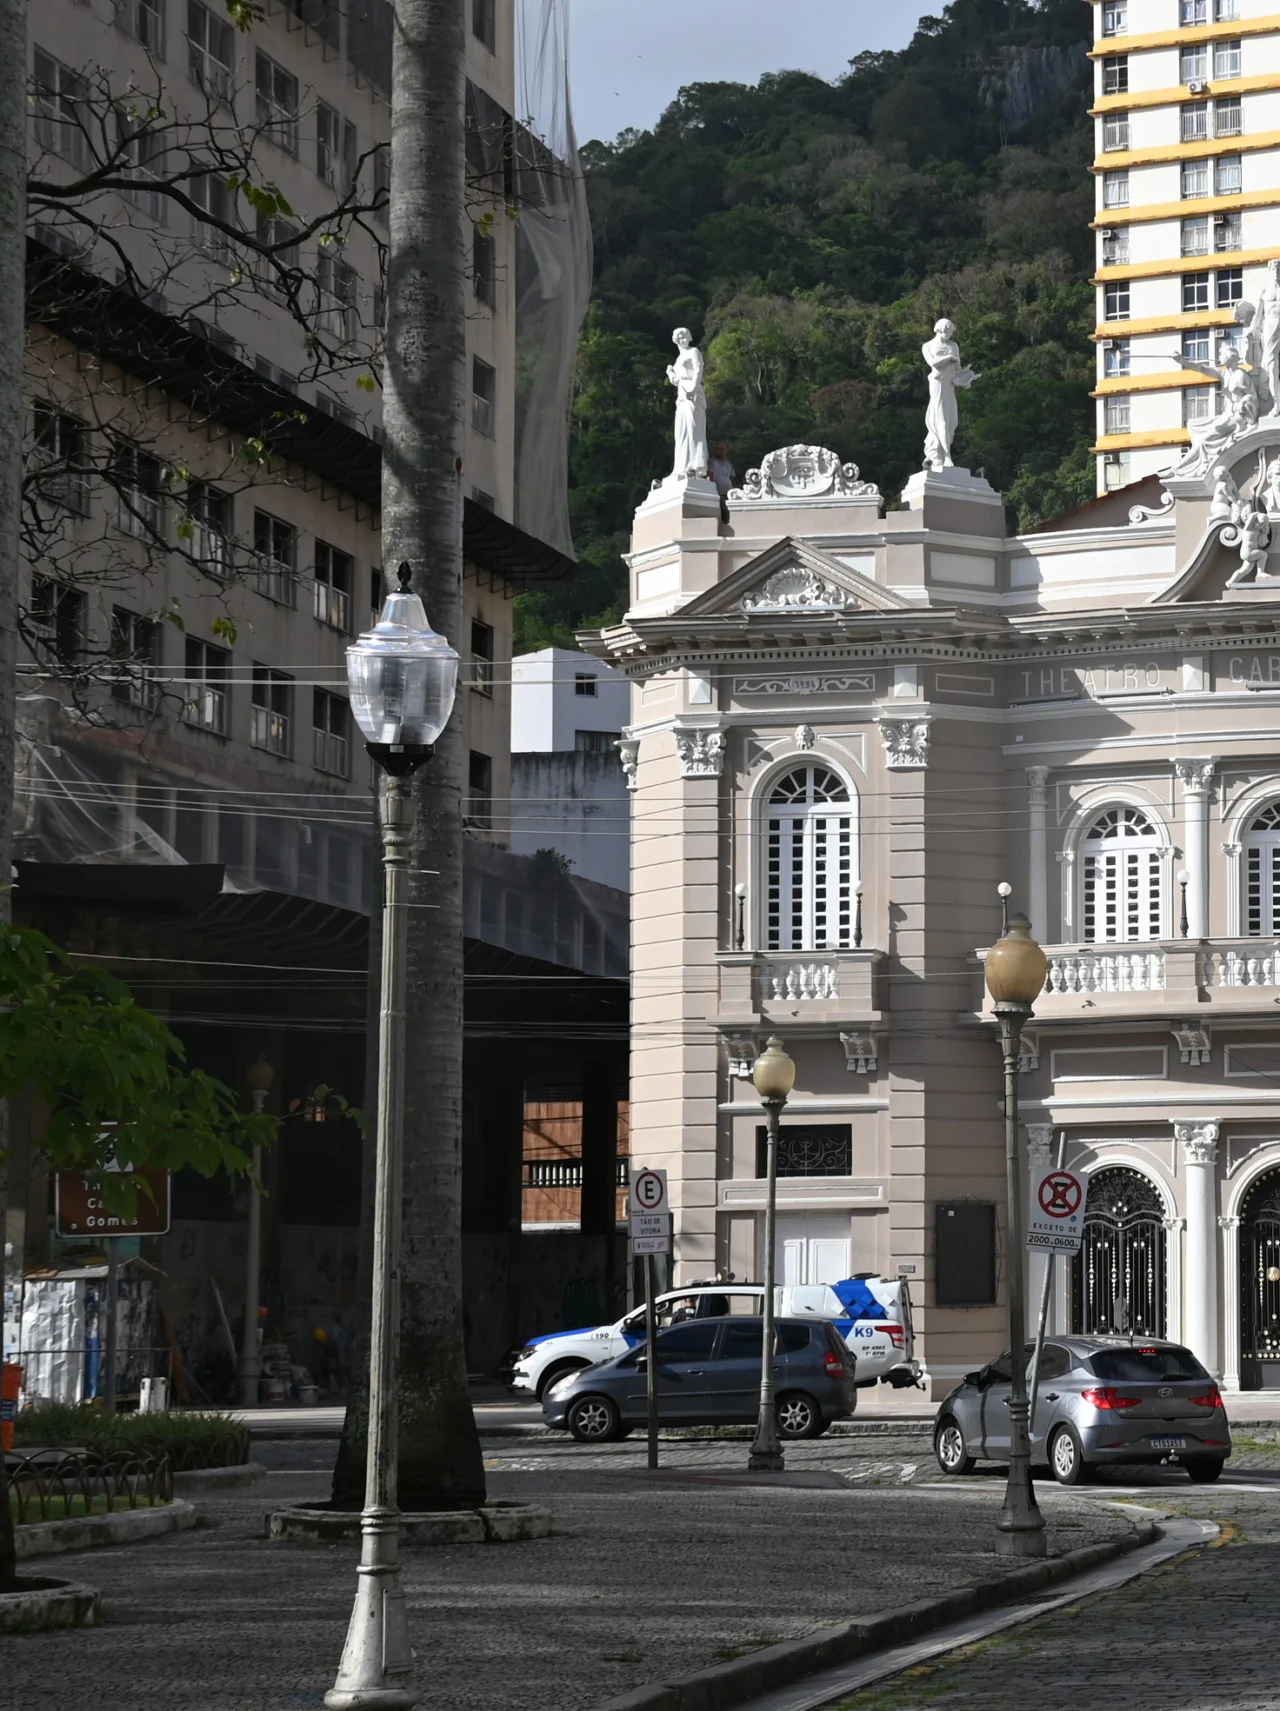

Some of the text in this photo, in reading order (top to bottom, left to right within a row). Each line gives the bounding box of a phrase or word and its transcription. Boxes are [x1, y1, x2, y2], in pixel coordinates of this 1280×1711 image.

[1021, 662, 1161, 697] THEATRO
[645, 1181, 655, 1200] E
[1032, 1222, 1065, 1232] EXCETO
[855, 1327, 874, 1338] K9
